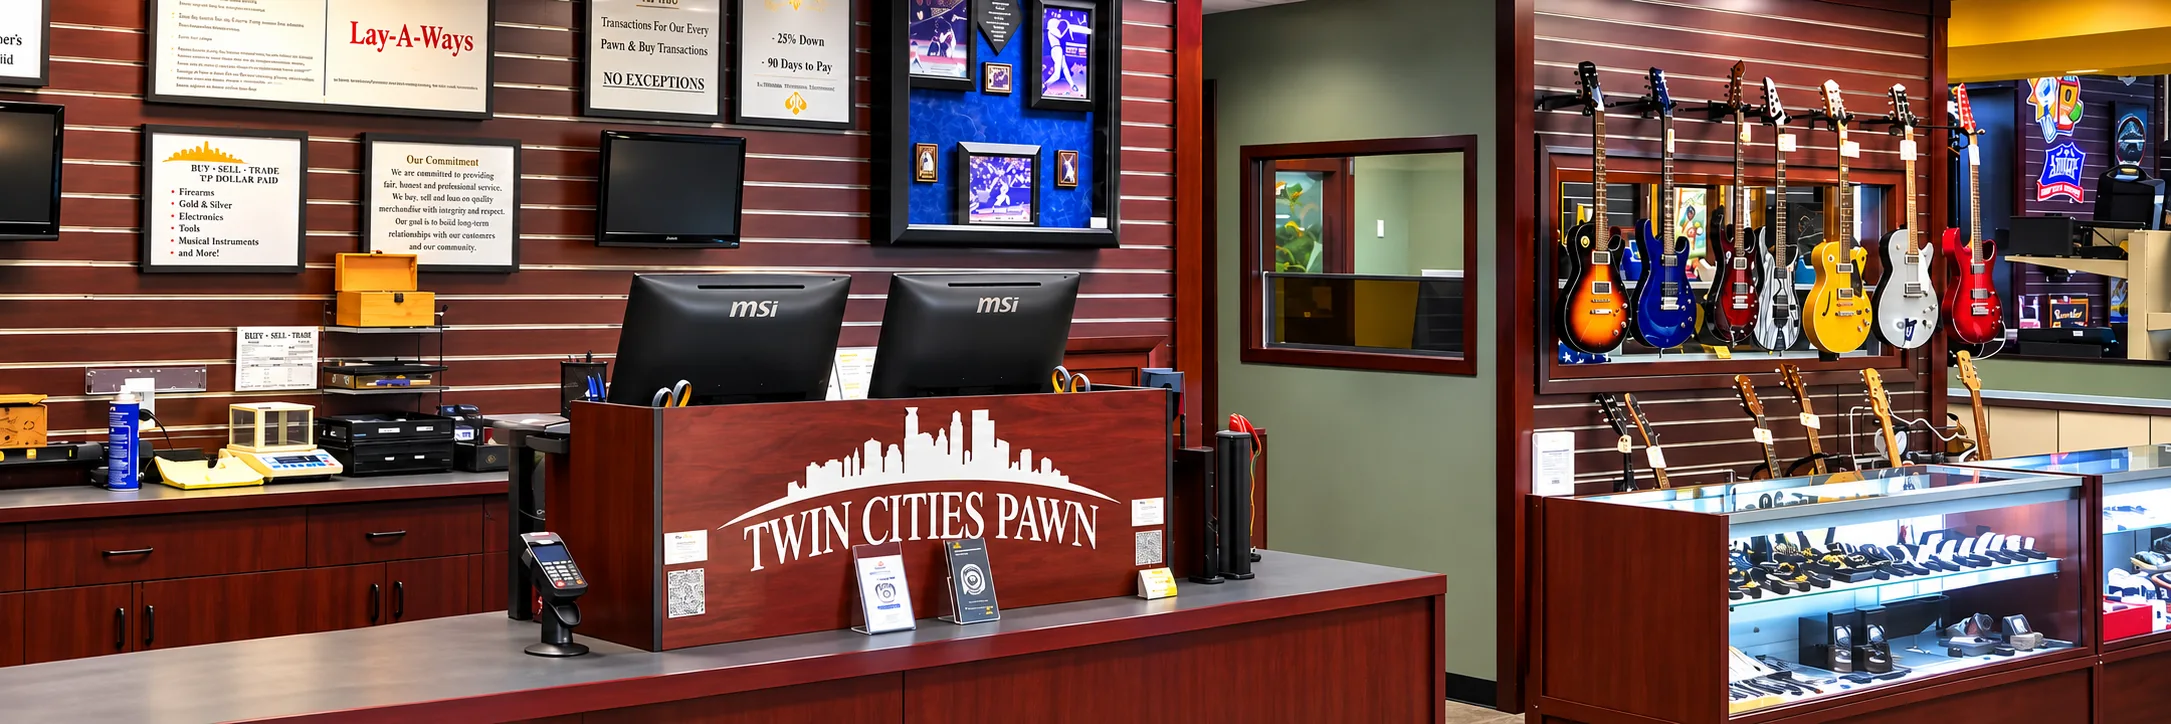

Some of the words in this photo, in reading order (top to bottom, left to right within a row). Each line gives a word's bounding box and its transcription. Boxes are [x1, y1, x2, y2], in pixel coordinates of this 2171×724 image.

[601, 17, 651, 30] Transactions
[654, 21, 667, 31] For
[669, 22, 684, 32] Our
[687, 23, 709, 37] Every
[349, 21, 474, 57] Lay-A-Ways
[778, 33, 796, 44] 25%
[800, 35, 824, 46] Down
[601, 39, 625, 50] Pawn
[628, 41, 635, 51] &
[639, 41, 655, 55] Buy
[657, 43, 708, 55] Transactions
[768, 58, 778, 68] 90
[781, 59, 802, 72] Days
[806, 62, 813, 70] to
[817, 61, 832, 74] Pay
[603, 71, 623, 86] NO
[626, 73, 705, 91] EXCEPTIONS
[407, 155, 423, 164] Our
[426, 156, 478, 166] Commitment
[216, 175, 254, 183] DOLLAR
[180, 188, 214, 196] Firearms
[210, 201, 232, 209] Silver
[179, 224, 200, 232] Tools
[179, 237, 209, 245] Musical
[196, 249, 219, 257] More!
[728, 300, 780, 318] msi
[976, 296, 1019, 314] msi
[743, 500, 852, 572] TWIN
[862, 491, 985, 546] CITIES
[995, 492, 1100, 550] PAWN
